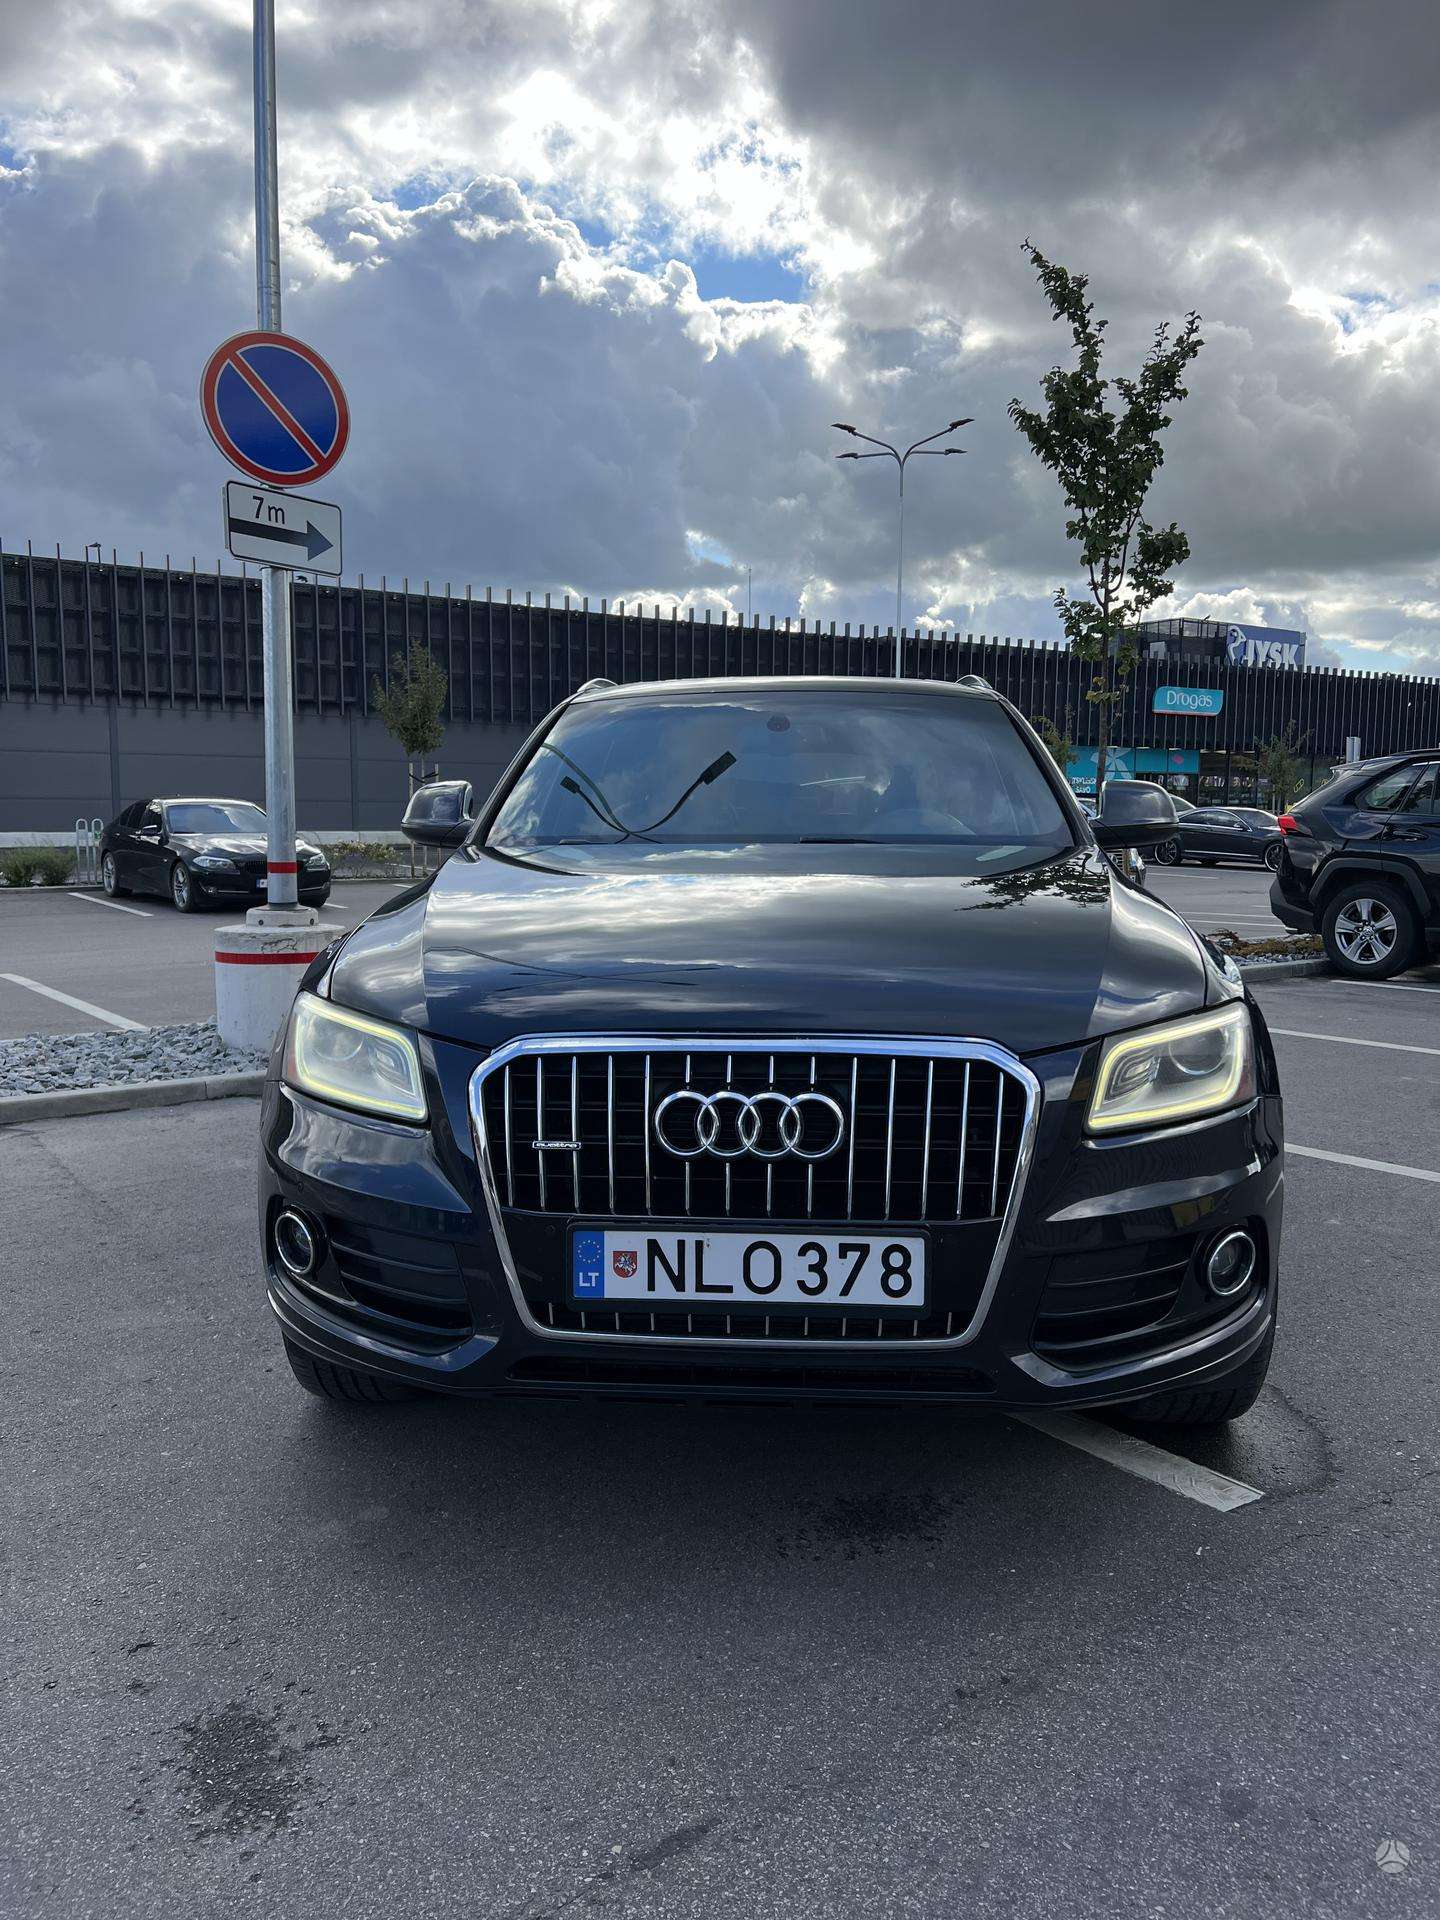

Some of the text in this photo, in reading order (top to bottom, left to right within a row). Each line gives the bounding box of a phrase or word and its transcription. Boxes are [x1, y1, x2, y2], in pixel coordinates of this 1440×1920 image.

[1241, 639, 1299, 671] JYSK
[1167, 690, 1213, 710] Drogas
[579, 1272, 599, 1287] LT
